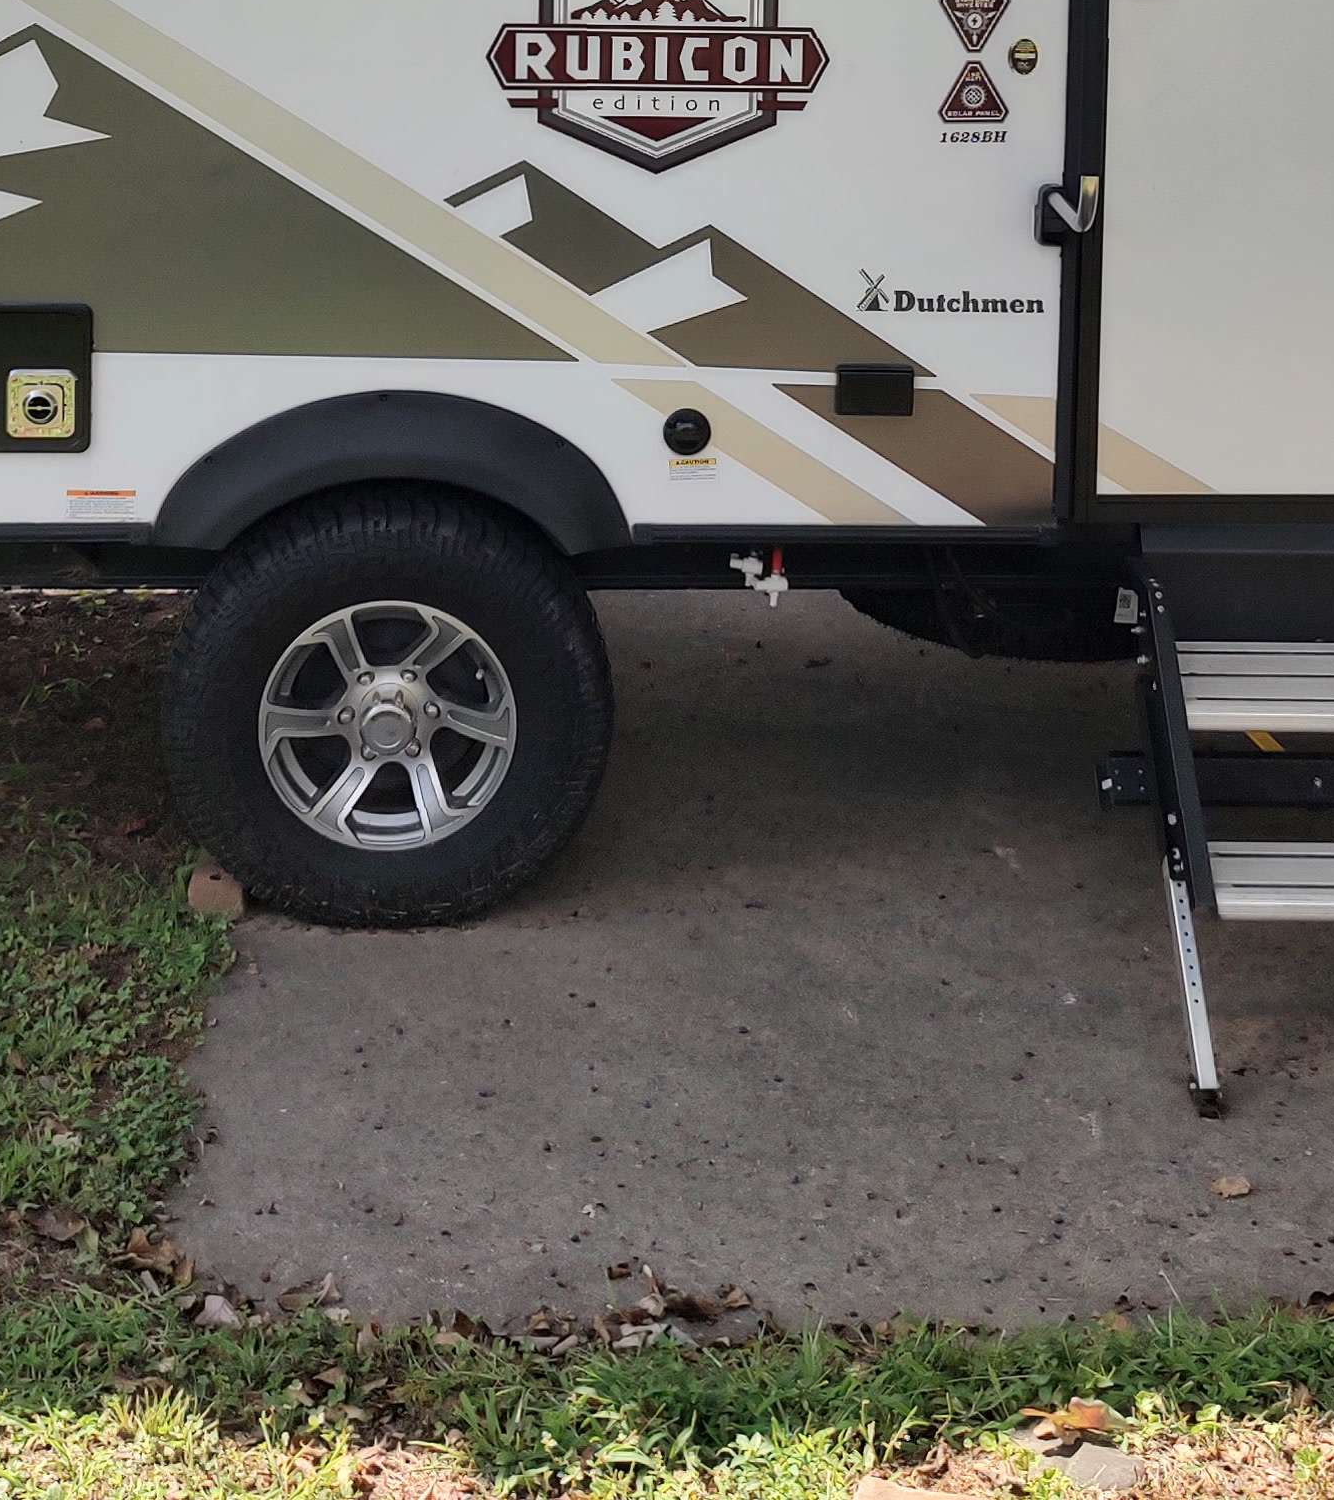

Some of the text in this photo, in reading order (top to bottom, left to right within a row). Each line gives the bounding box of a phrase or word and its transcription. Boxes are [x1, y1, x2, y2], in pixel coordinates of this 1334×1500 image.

[514, 33, 805, 84] RUBICON
[592, 94, 720, 112] edition
[940, 130, 1008, 143] 1628BH
[893, 290, 1045, 313] Dutchmen
